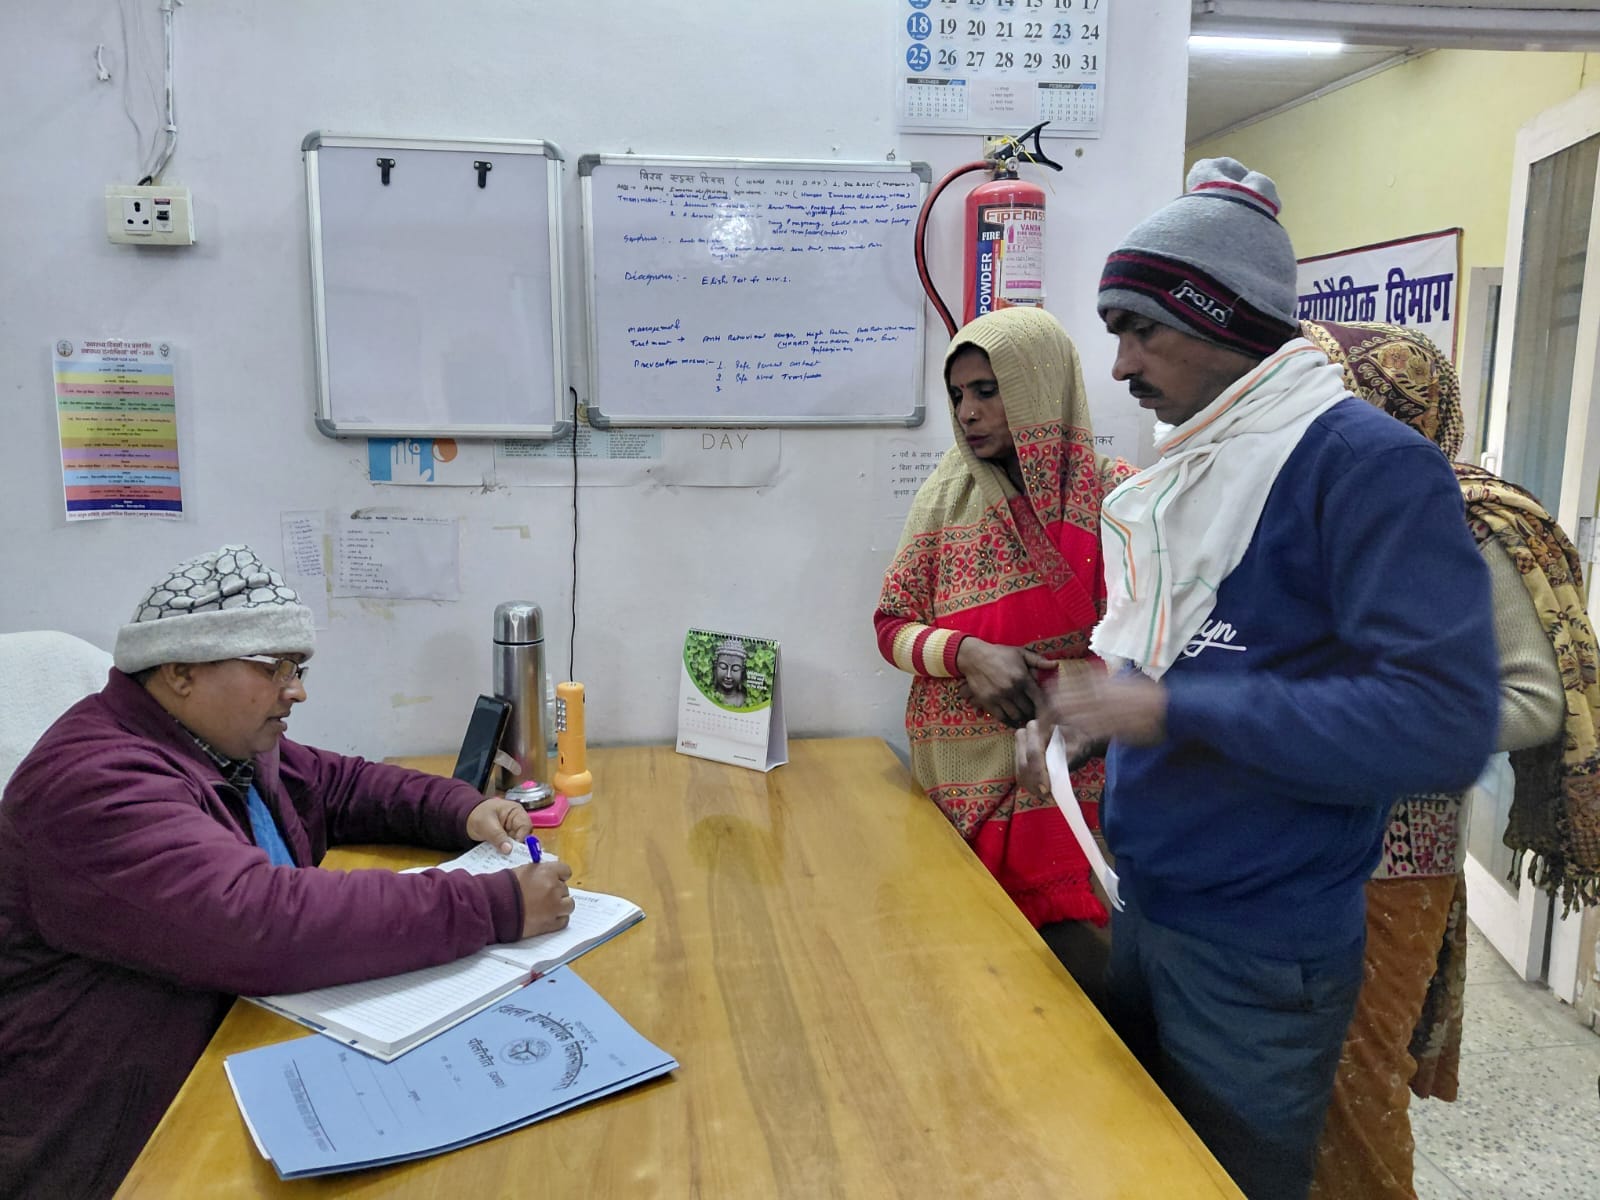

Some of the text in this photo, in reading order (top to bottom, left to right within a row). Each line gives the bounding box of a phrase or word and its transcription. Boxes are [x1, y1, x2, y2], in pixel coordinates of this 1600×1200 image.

[910, 16, 1100, 40] 18 19 20 21 22 23 24
[909, 47, 1098, 70] 25 26 27 28 29 30 31
[982, 231, 1001, 241] FIRE
[980, 252, 993, 314] POWDER
[1386, 267, 1454, 325] विभाग
[701, 433, 749, 450] DAY
